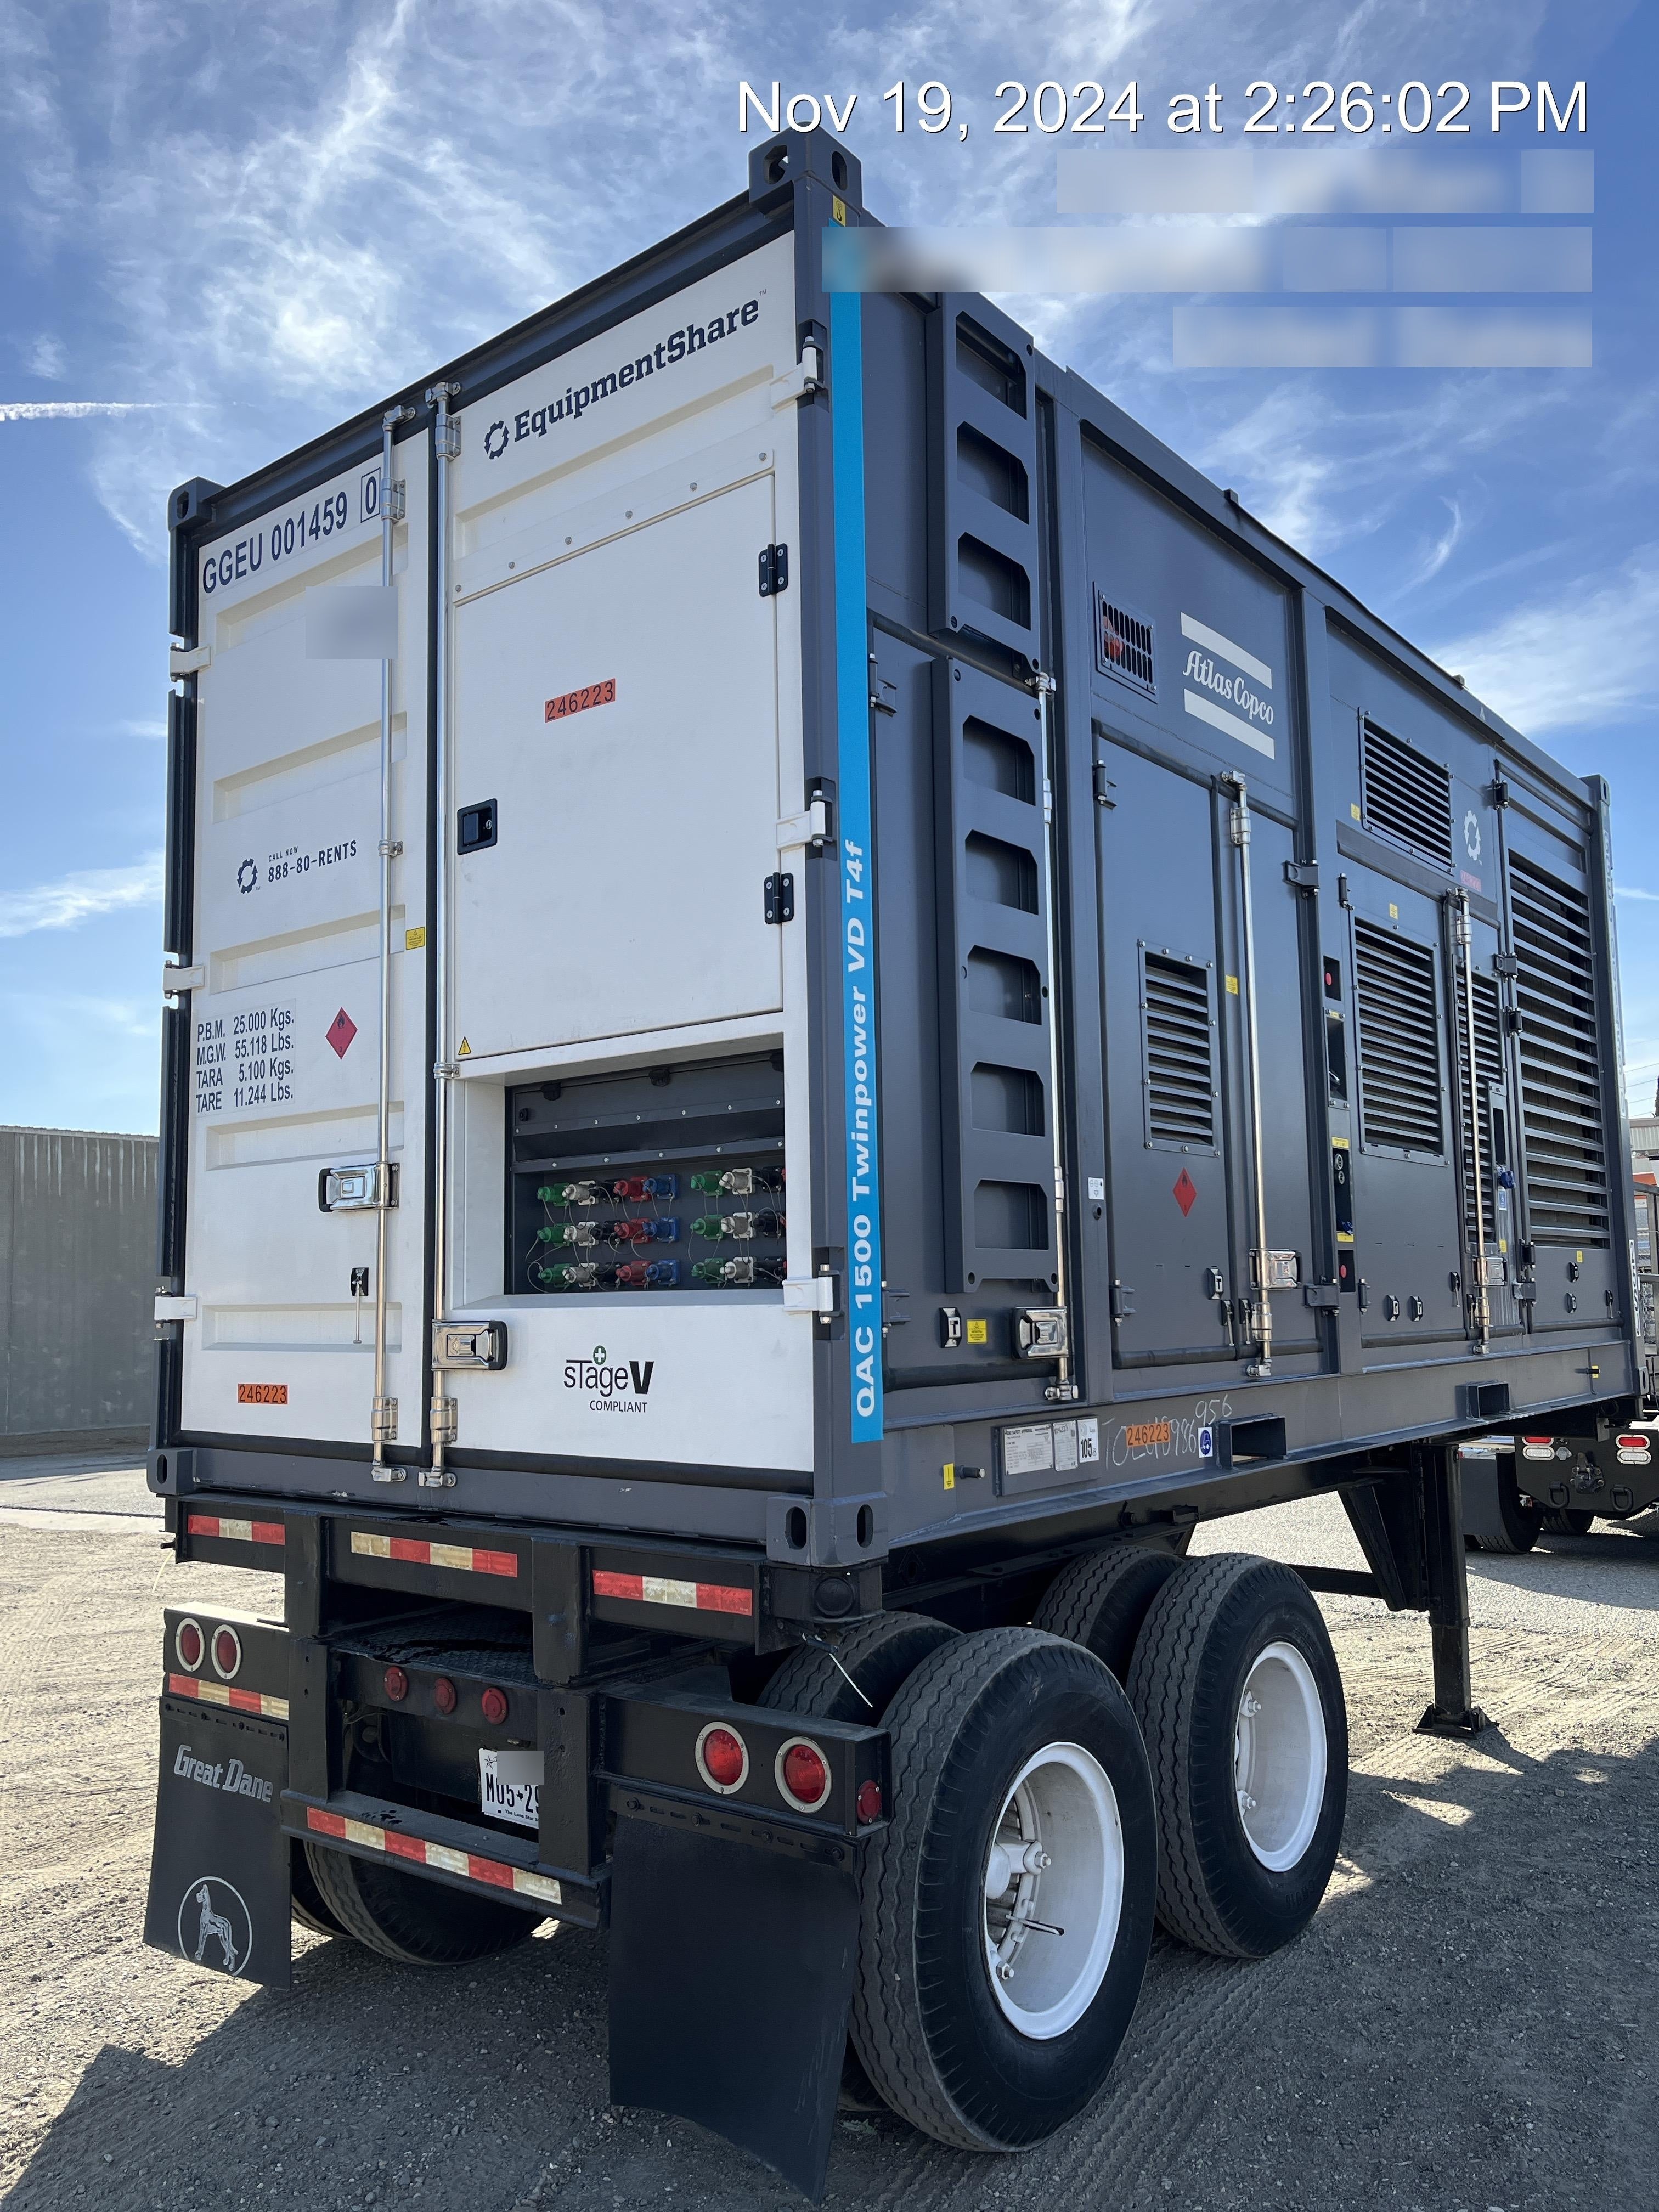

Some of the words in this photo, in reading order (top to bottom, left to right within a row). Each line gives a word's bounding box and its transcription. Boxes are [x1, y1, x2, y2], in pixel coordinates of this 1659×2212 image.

[514, 299, 759, 443] EquipmentShare
[202, 532, 263, 594] GGEU
[271, 491, 348, 561] 001459
[365, 476, 377, 515] 0
[546, 681, 613, 721] 246223
[1182, 650, 1233, 699] Atlas
[1233, 676, 1274, 725] Copco
[268, 852, 283, 862] CALL
[285, 846, 298, 857] NOW
[268, 840, 357, 883] 888-80-RENTS
[844, 839, 864, 904] T4f
[847, 917, 865, 973] VD
[197, 1019, 225, 1042] P.B.M.
[233, 1010, 266, 1035] 25.000
[270, 1007, 294, 1031] Kgs.
[196, 1042, 226, 1066] M.G.W.
[235, 1034, 267, 1059] 55.118
[271, 1032, 294, 1052] Lbs.
[196, 1067, 223, 1089] TARA
[238, 1059, 266, 1082] 5.100
[270, 1057, 294, 1081] Kgs.
[195, 1091, 222, 1113] TARE
[233, 1084, 267, 1107] 11.244
[270, 1081, 294, 1102] Lbs.
[851, 986, 872, 1202] Twinpower
[853, 1214, 873, 1309] 1500
[629, 1361, 654, 1395] V
[856, 1326, 875, 1418] QAC
[239, 1385, 286, 1403] 246223
[589, 1400, 648, 1413] COMPLIANT
[1081, 1438, 1092, 1459] 105
[1127, 1423, 1169, 1446] 246223
[173, 1744, 224, 1788] Great
[222, 1758, 274, 1803] Dane
